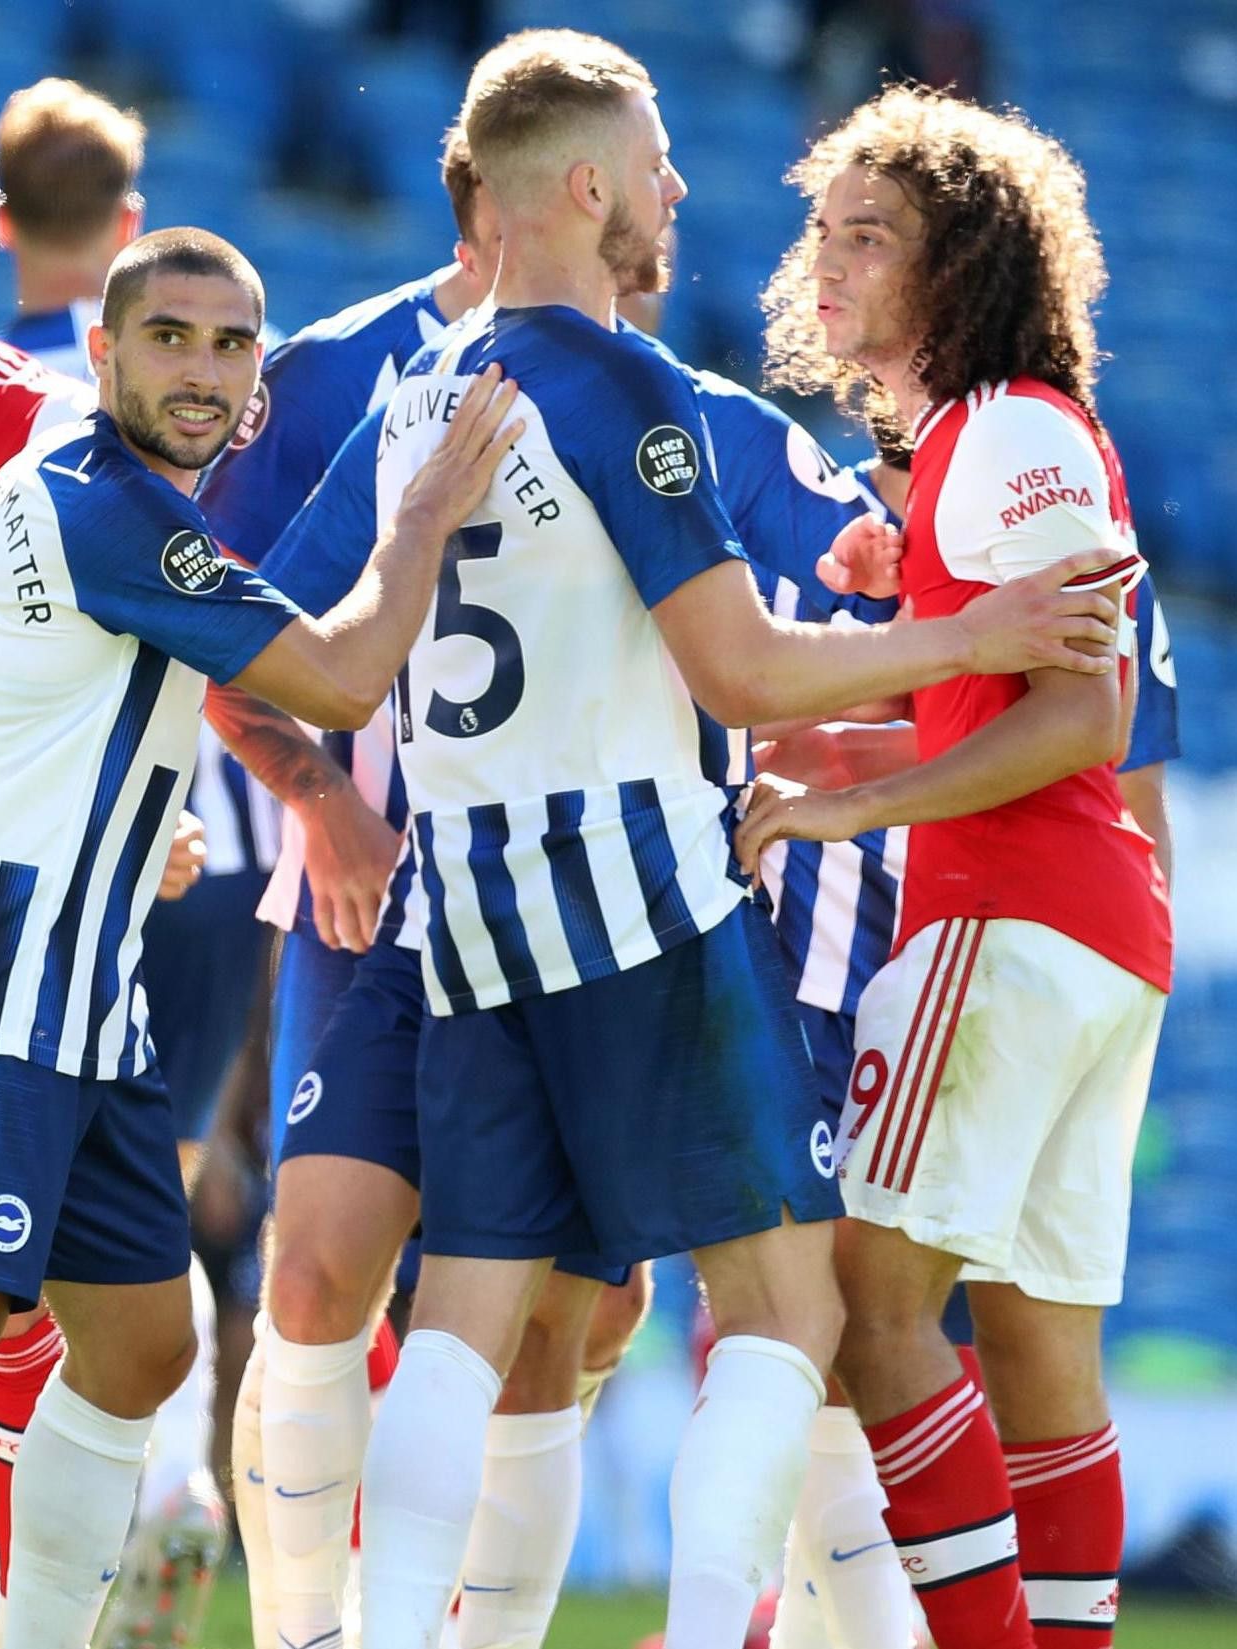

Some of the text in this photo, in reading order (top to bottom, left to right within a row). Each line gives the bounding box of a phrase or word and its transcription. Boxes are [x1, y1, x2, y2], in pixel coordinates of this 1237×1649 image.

[406, 388, 460, 429] LIVE
[1006, 466, 1061, 496] VISIT
[999, 486, 1095, 529] RWANDA
